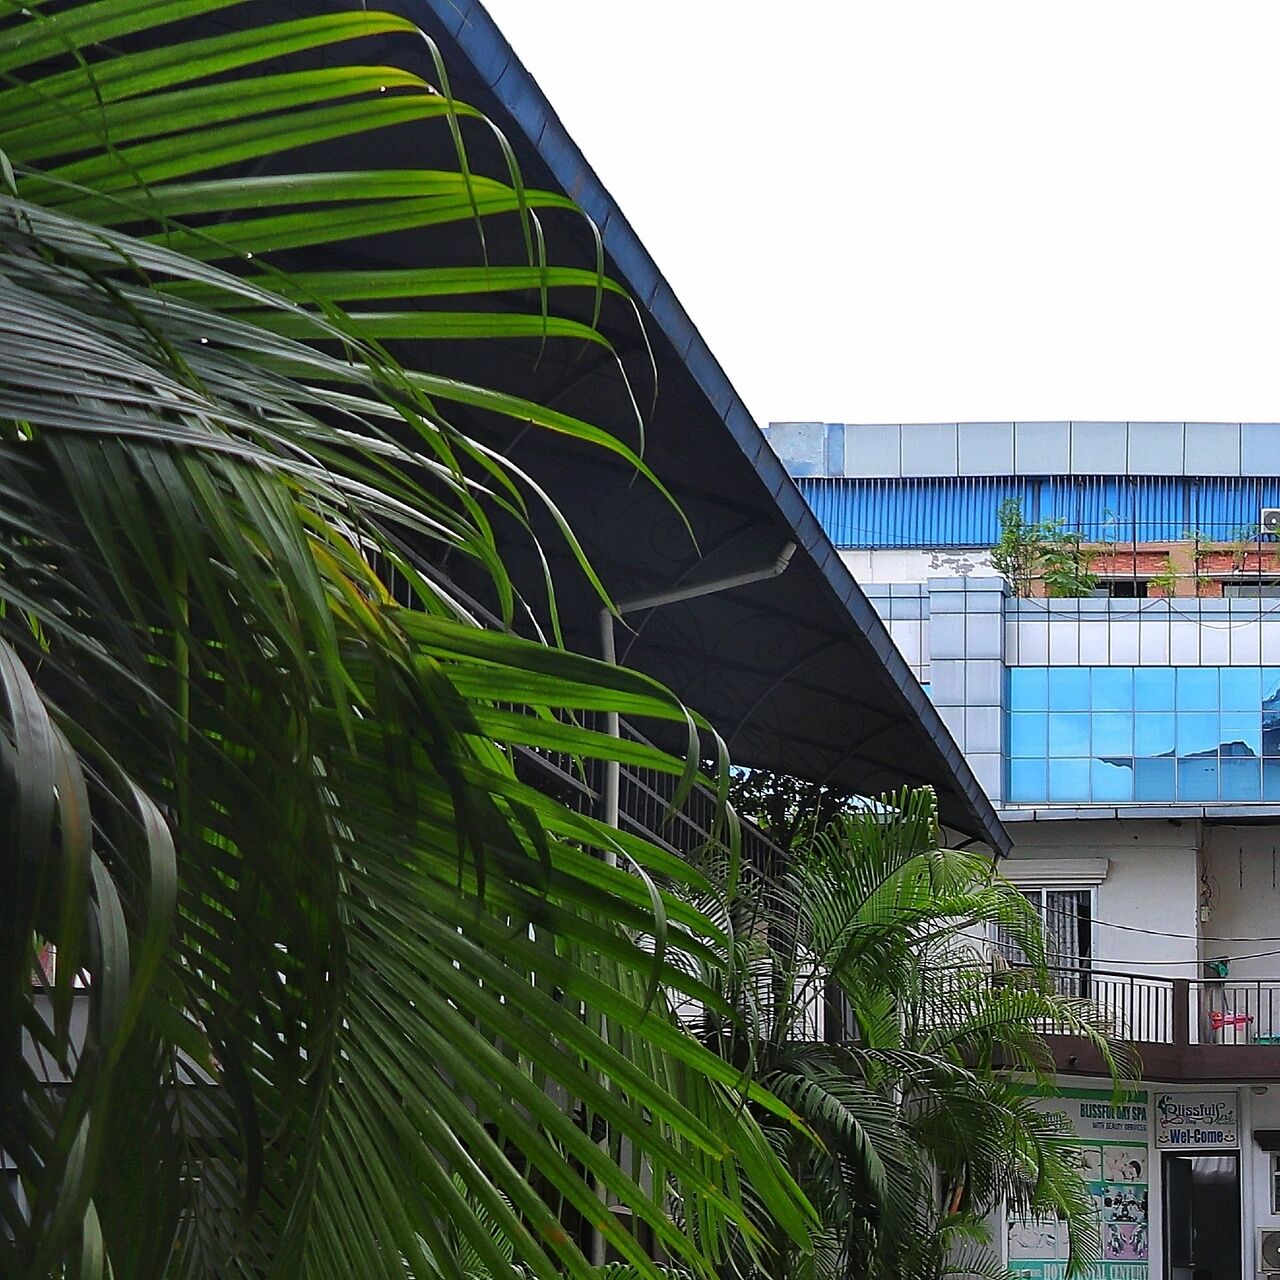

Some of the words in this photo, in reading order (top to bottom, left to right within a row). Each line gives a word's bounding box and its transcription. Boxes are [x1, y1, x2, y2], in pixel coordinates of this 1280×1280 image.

[1080, 1103, 1115, 1120] BLISSFUL
[1116, 1105, 1130, 1120] DAY
[1131, 1106, 1147, 1121] SPA
[1158, 1102, 1215, 1120] Blissful
[1169, 1128, 1224, 1144] Wel-Come
[1043, 1263, 1070, 1280] HOT
[1110, 1264, 1148, 1280] CENTURY
